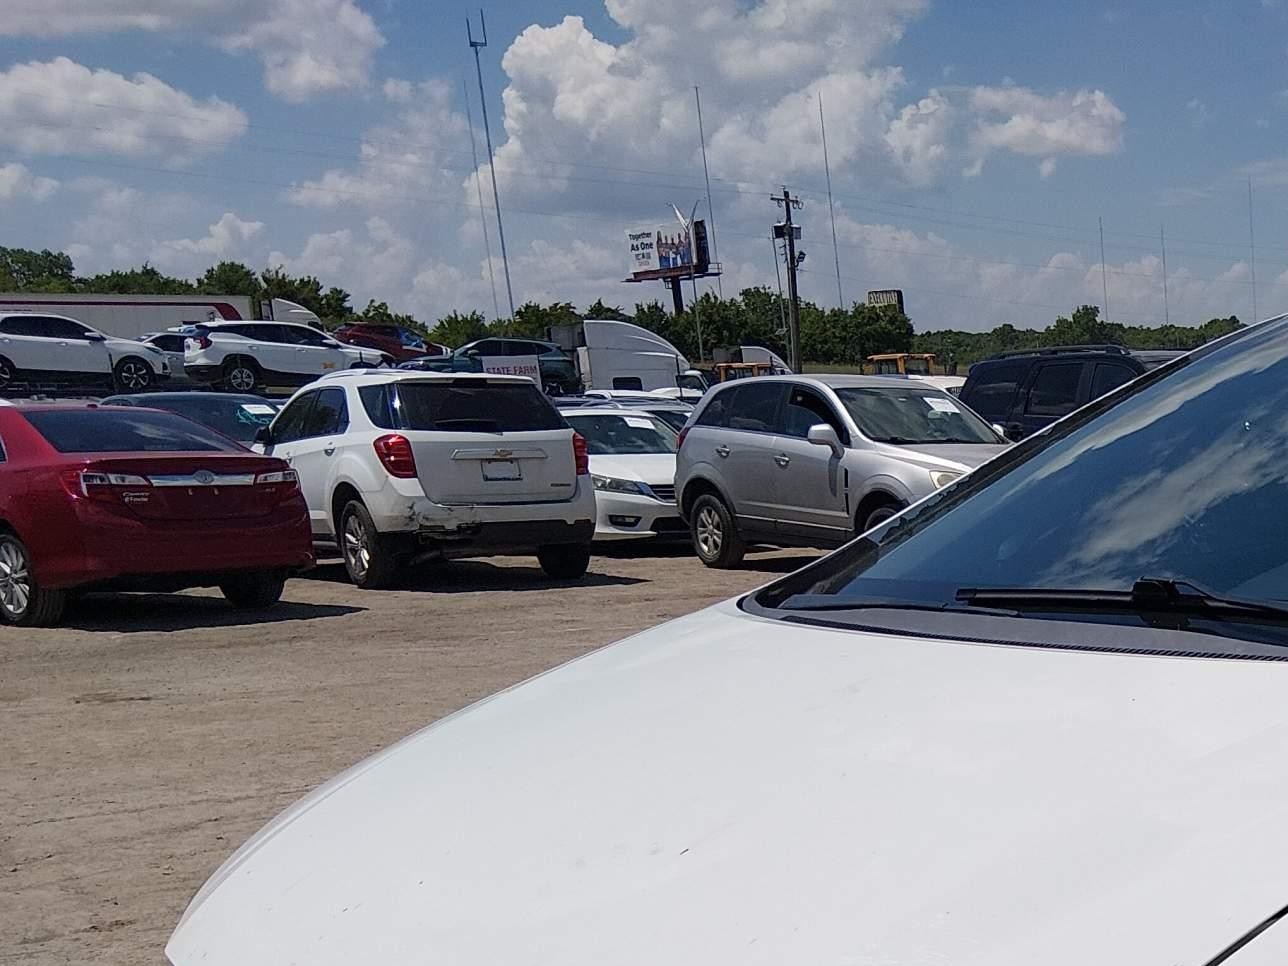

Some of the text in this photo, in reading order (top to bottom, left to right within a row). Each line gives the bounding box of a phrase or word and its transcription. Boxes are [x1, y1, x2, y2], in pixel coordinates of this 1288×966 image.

[629, 232, 651, 242] Together
[631, 241, 653, 252] As One
[486, 366, 511, 375] STATE
